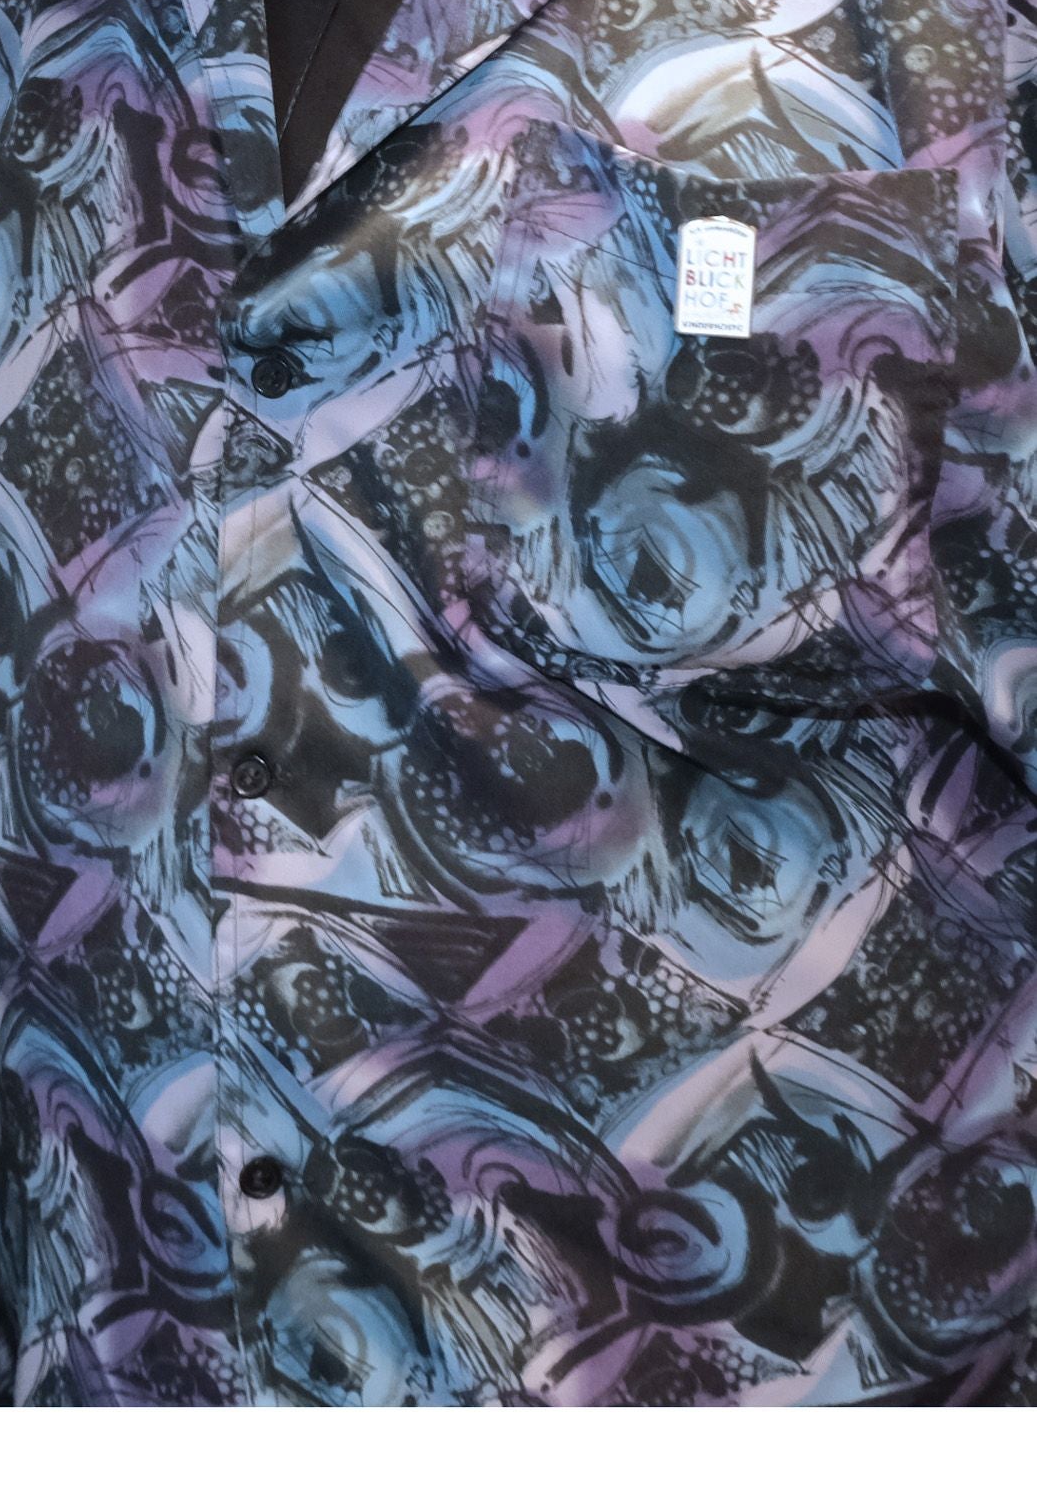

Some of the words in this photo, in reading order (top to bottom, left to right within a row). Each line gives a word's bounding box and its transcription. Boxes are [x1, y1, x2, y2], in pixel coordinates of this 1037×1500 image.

[686, 248, 748, 268] LICHT
[685, 269, 746, 289] BLICK
[684, 290, 728, 308] HOF
